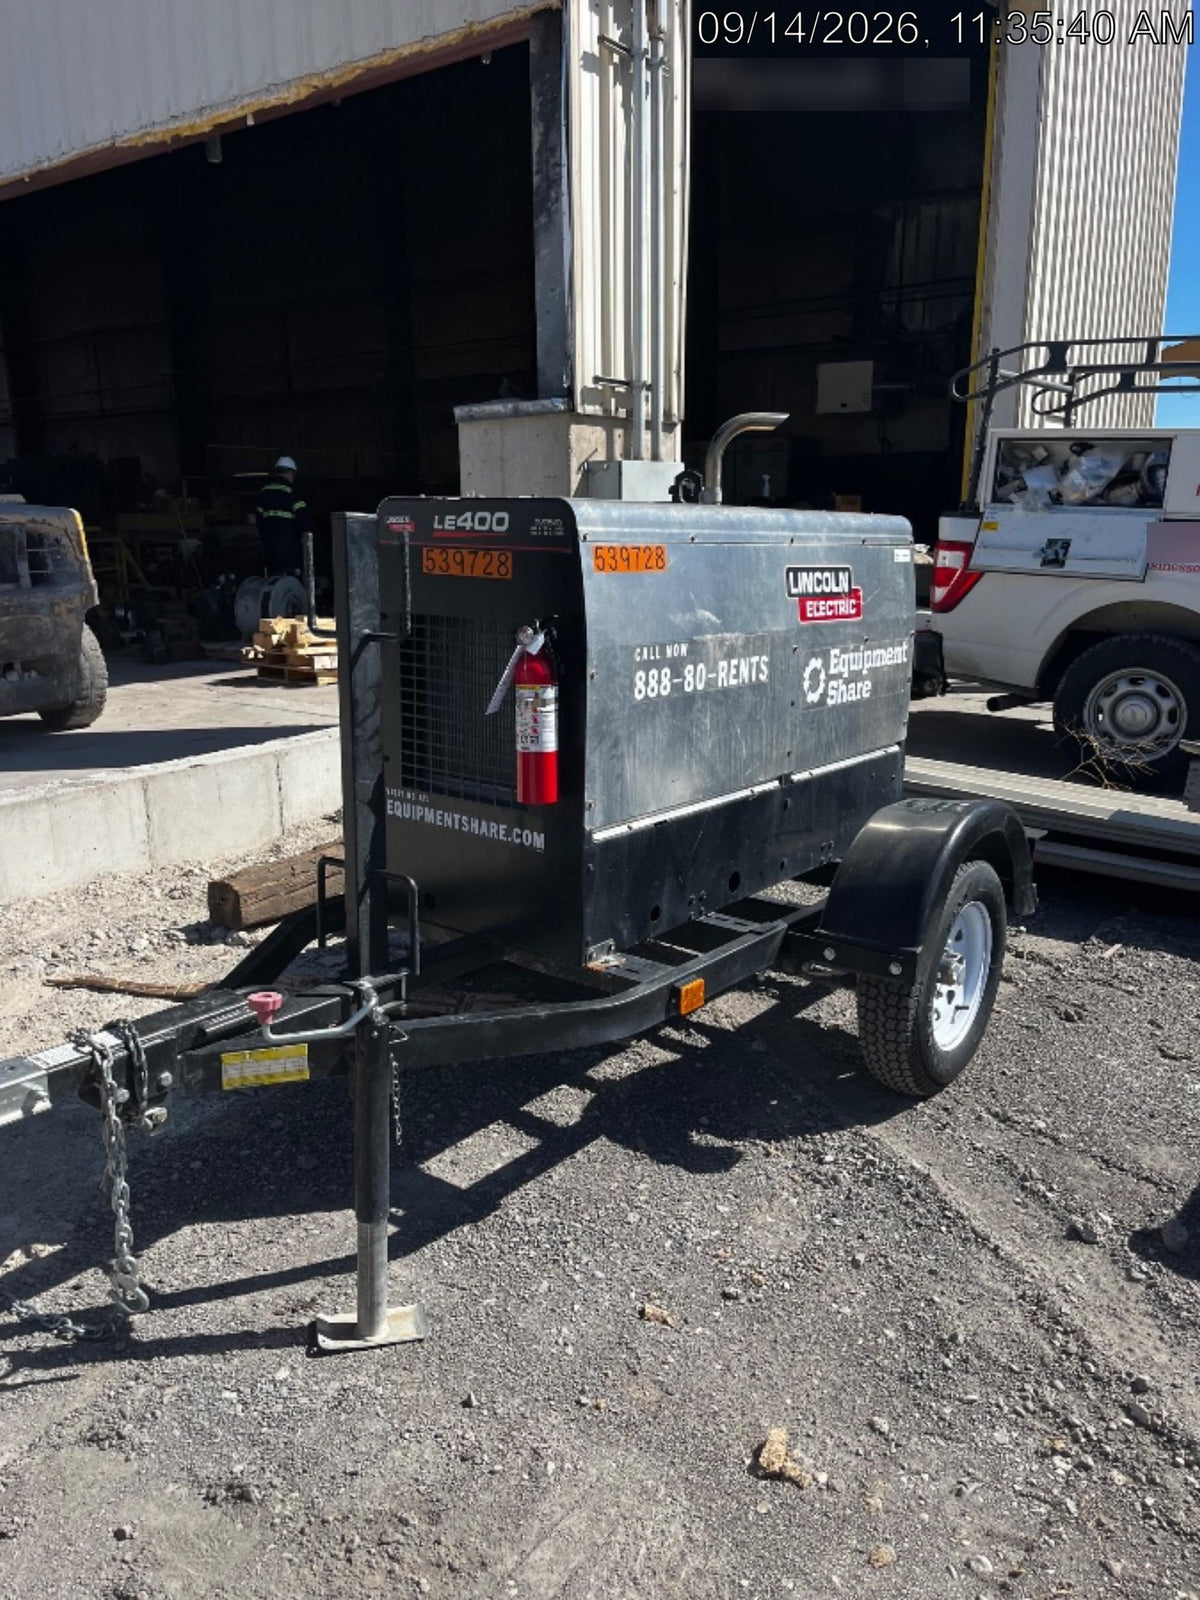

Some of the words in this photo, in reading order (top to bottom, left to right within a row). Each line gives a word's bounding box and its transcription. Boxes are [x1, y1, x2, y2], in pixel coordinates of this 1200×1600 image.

[433, 511, 510, 532] LE400
[425, 549, 511, 577] 539728
[594, 545, 667, 572] 539728
[788, 570, 850, 594] LINCOLN
[806, 599, 857, 618] ELECTRIC
[634, 645, 661, 662] CALL
[666, 643, 689, 658] NOW
[829, 641, 908, 679] Equipment
[634, 655, 770, 700] 888-80-RENTS
[826, 678, 873, 706] Share
[386, 799, 545, 851] EQUIPMENTSHARE.COM
